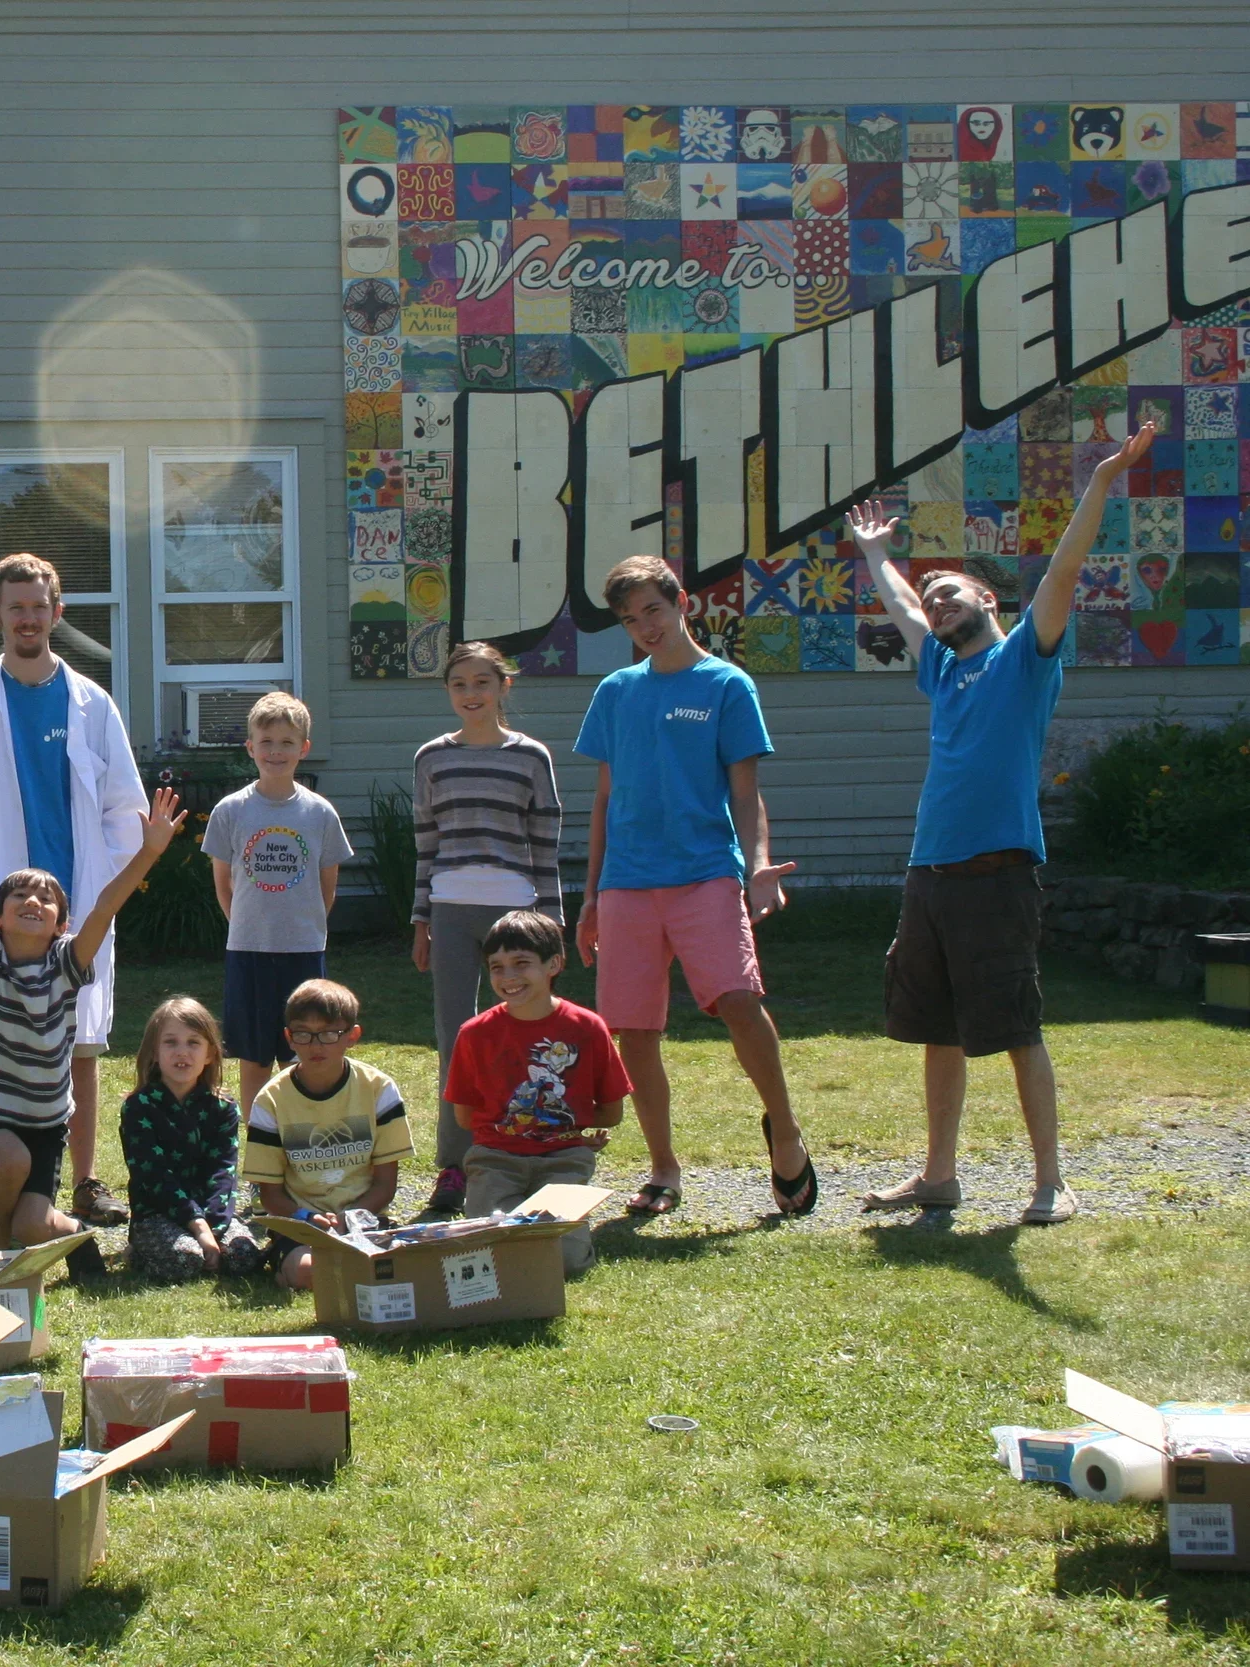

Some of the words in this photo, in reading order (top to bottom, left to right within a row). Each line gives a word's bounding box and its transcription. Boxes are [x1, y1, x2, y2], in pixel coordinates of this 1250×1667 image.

[455, 234, 708, 301] Welcome
[266, 842, 288, 852] New
[255, 853, 276, 862] York
[278, 853, 298, 864] City
[254, 863, 298, 874] Subways
[314, 1140, 372, 1159] balance
[292, 1155, 367, 1173] BASKETBALL
